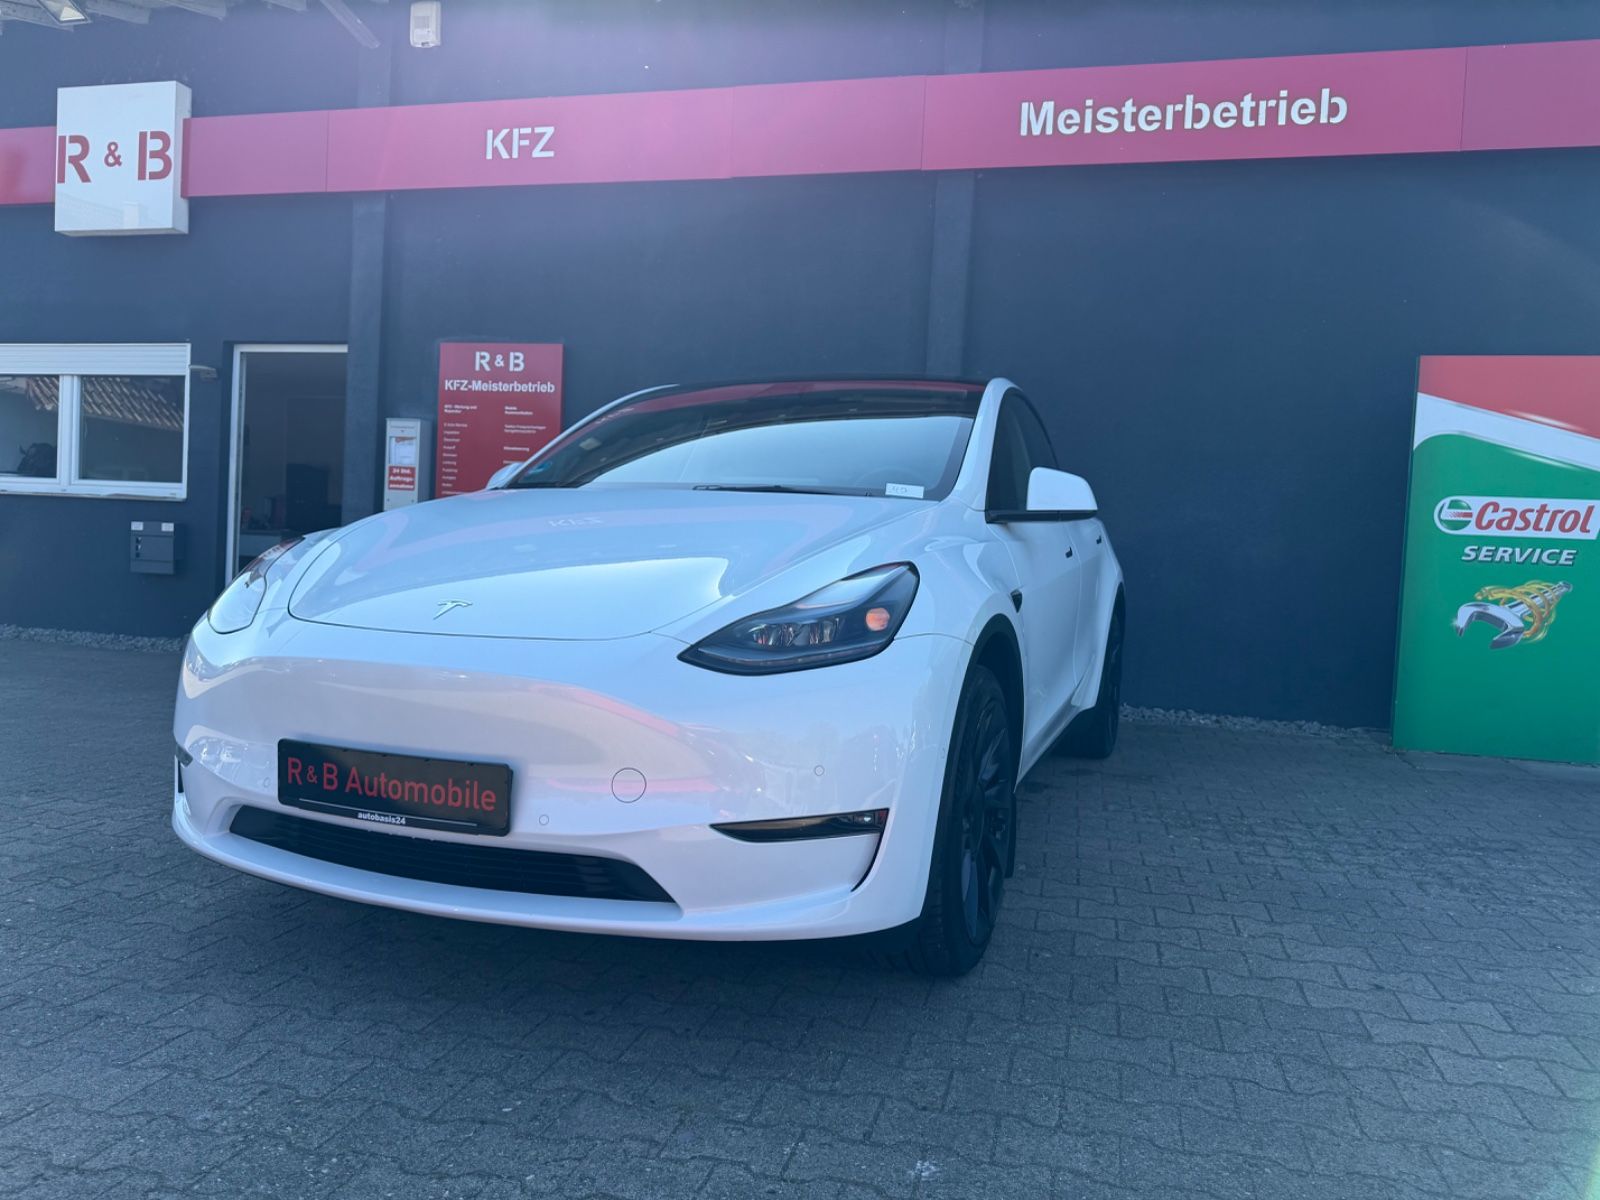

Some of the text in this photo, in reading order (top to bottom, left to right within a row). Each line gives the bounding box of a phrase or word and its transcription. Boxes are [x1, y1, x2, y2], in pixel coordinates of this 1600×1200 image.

[1020, 88, 1348, 136] Meisterbetrieb
[57, 131, 173, 184] R & B
[486, 126, 555, 160] KFZ
[475, 351, 525, 372] R & B
[444, 379, 556, 393] KFZ-Meisterbetrieb
[1475, 501, 1596, 534] Castrol
[1461, 546, 1577, 566] SERVICE
[287, 757, 497, 812] R & B Automobile
[357, 811, 407, 826] autobasis24
